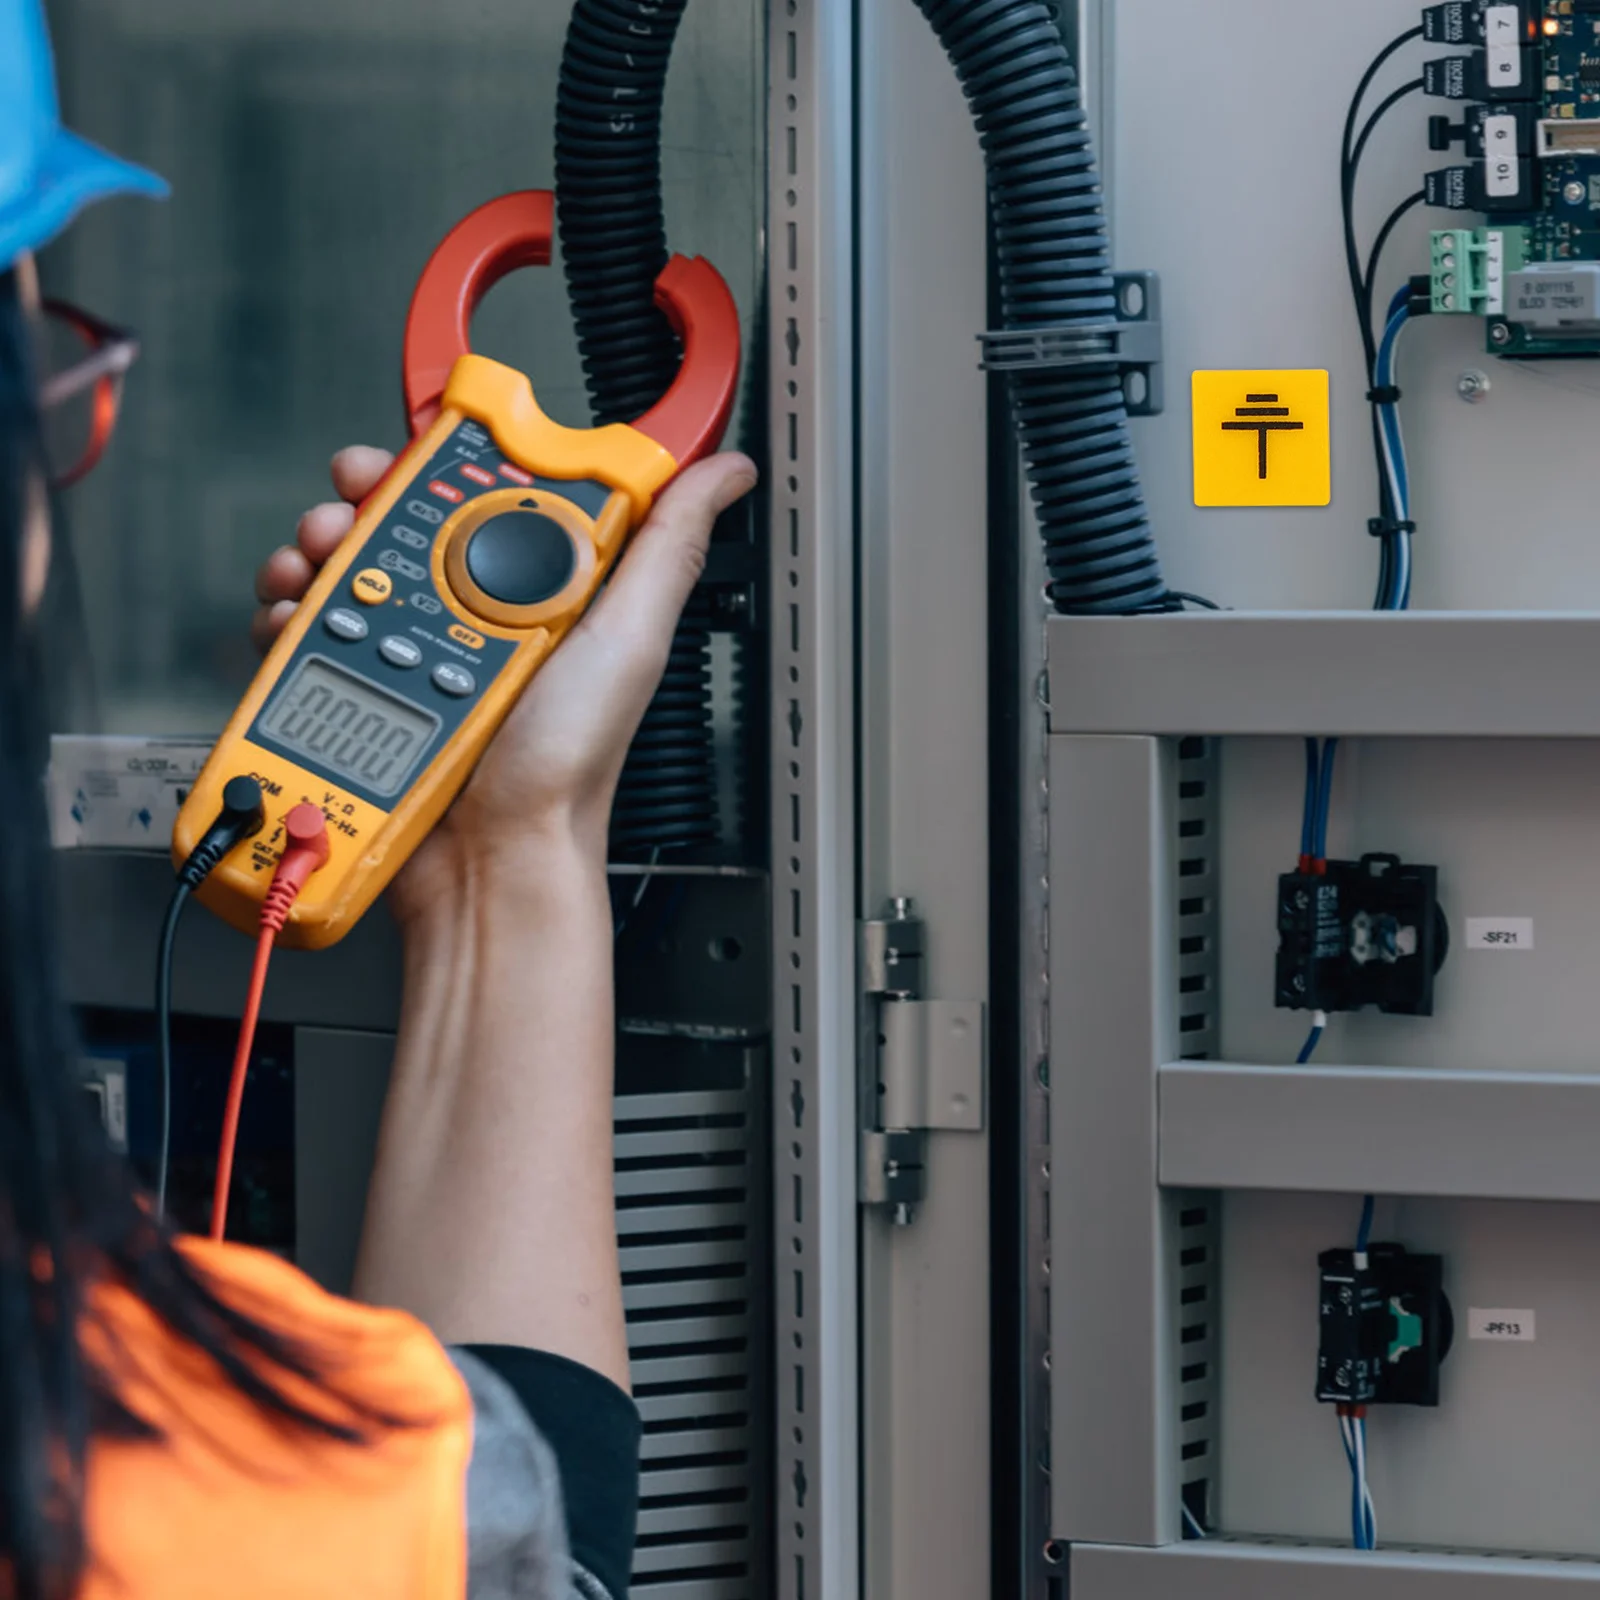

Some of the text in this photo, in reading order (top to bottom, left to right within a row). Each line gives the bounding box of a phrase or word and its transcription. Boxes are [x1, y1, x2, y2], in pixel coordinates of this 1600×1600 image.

[1497, 19, 1510, 29] 7
[1499, 62, 1512, 73] 8
[1495, 129, 1508, 140] 9
[1497, 163, 1509, 181] 10
[358, 574, 387, 594] HOLD
[454, 629, 477, 644] OFF
